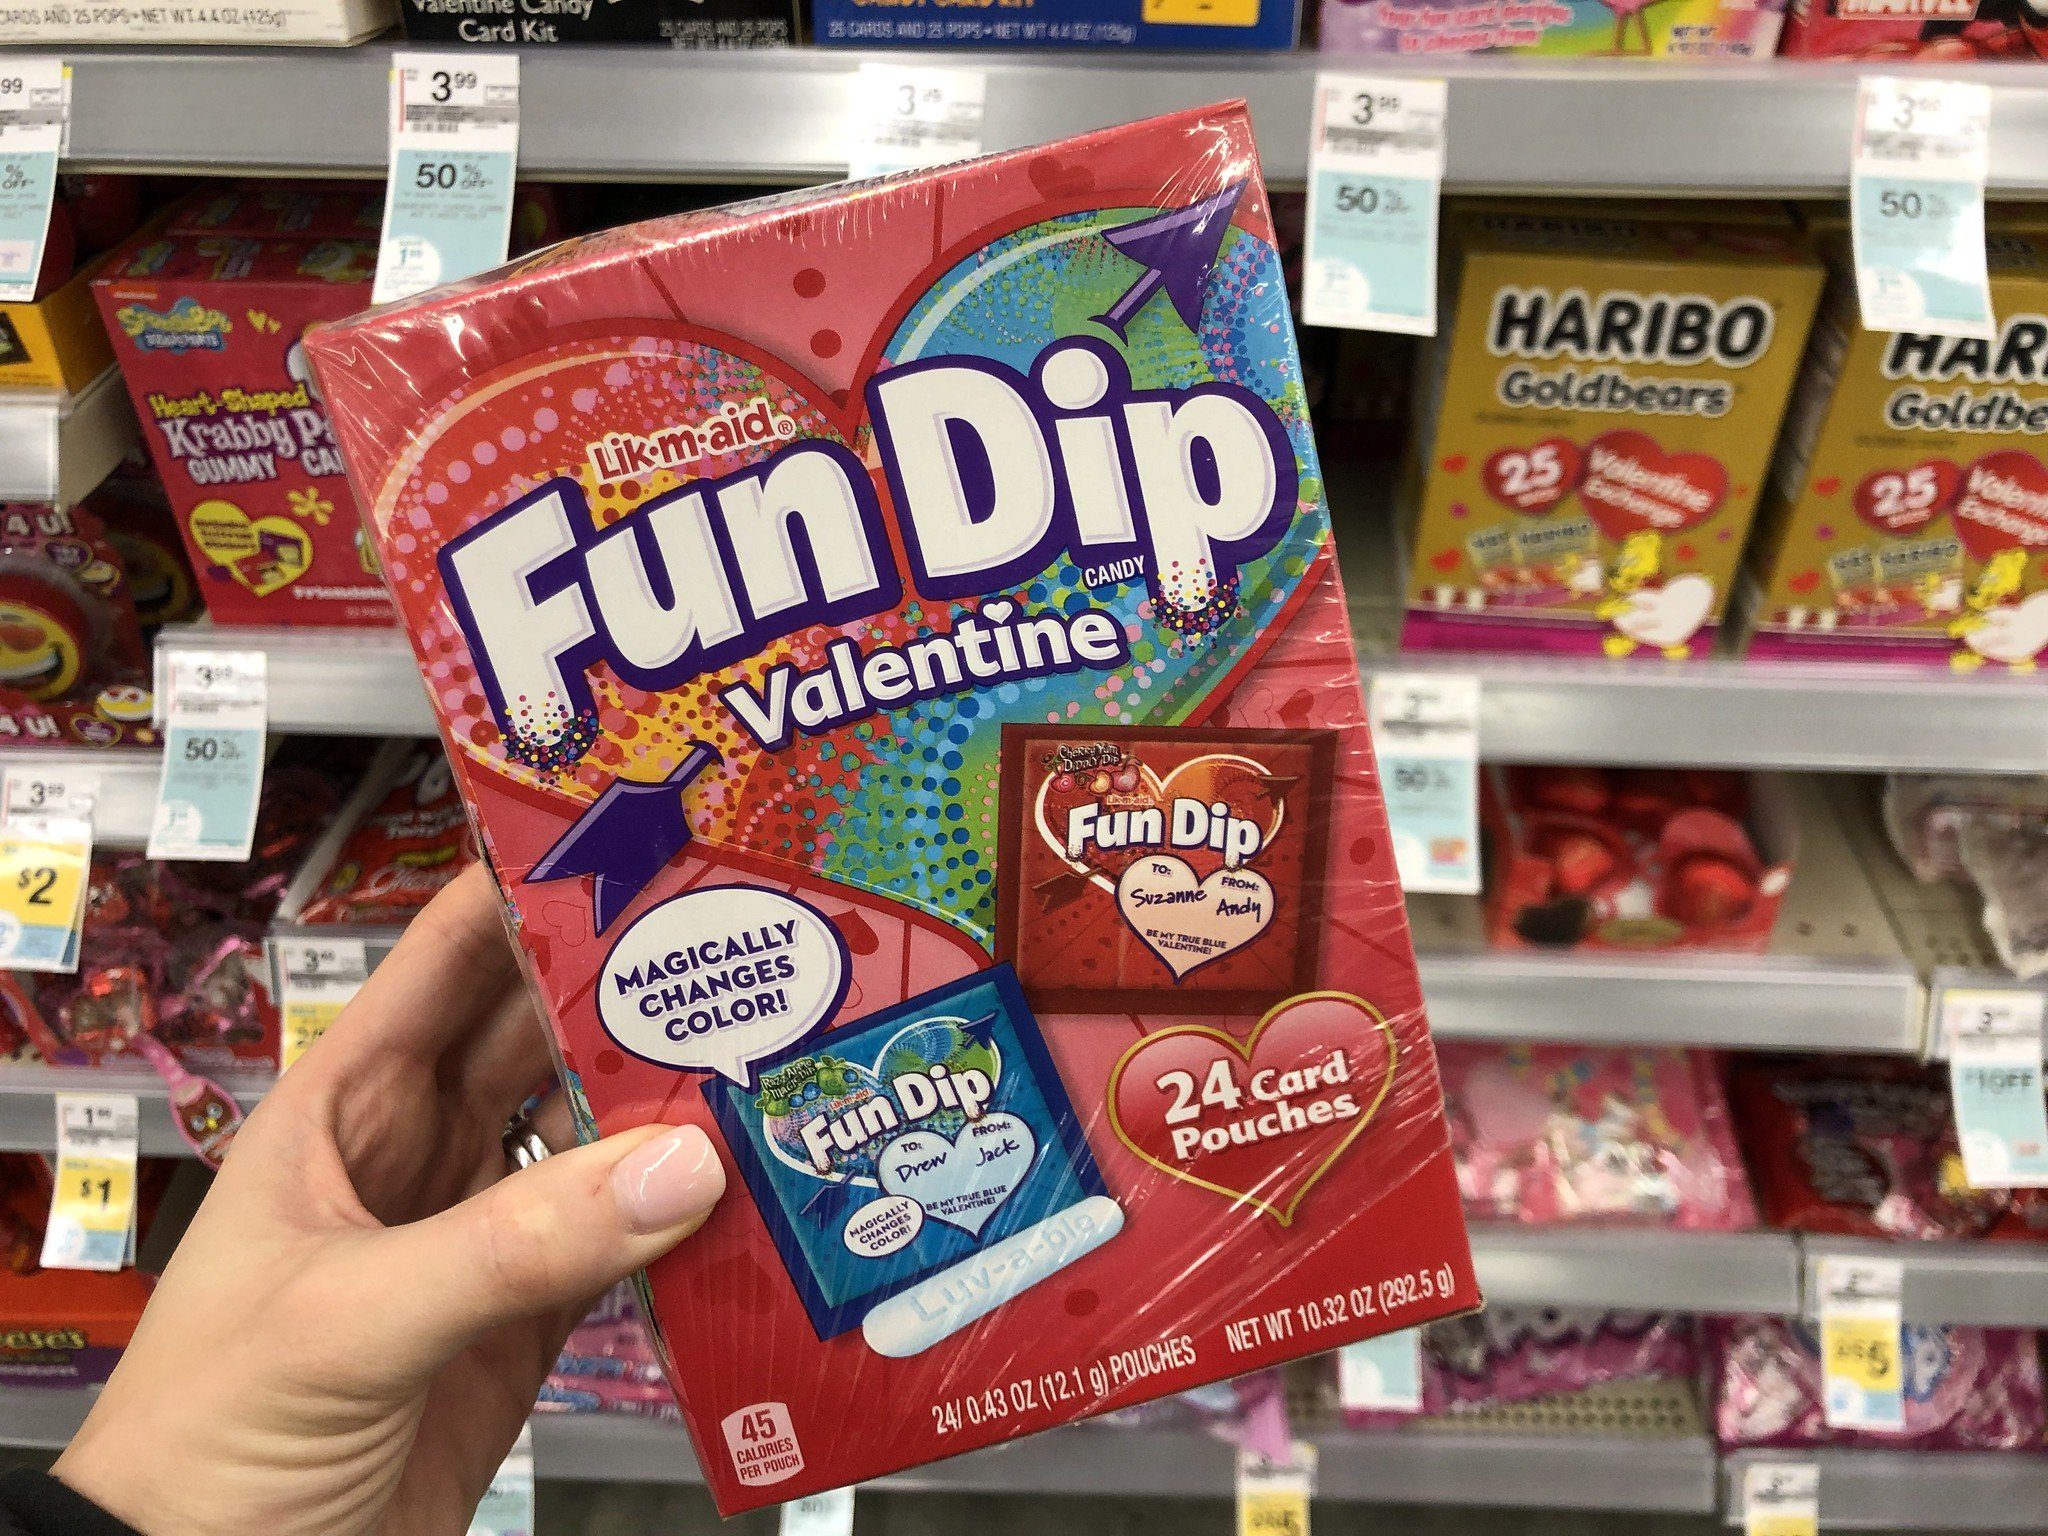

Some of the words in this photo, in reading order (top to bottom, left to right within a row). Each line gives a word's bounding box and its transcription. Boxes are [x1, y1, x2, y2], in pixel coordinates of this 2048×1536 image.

[459, 18, 516, 42] Card
[520, 19, 559, 42] Kit
[1490, 292, 1769, 361] HARIBO
[1501, 370, 1727, 415] Goldbears
[159, 416, 298, 459] Krabby
[187, 452, 277, 484] GUMMY
[1499, 445, 1563, 494] 25
[1872, 466, 1937, 517] 25
[451, 451, 880, 748] Fun
[877, 348, 1277, 611] Dip
[1085, 555, 1145, 588] CANDY
[724, 601, 1121, 745] Valentine
[1067, 802, 1163, 858] Fun
[1171, 798, 1261, 869] Dip
[1152, 863, 1171, 875] TO:
[1221, 876, 1259, 891] FROM:
[17, 867, 58, 905] $2
[1130, 888, 1207, 908] Suzanne
[1216, 896, 1262, 923] Andy
[1146, 928, 1157, 938] BE
[1161, 931, 1175, 941] MY
[1177, 933, 1200, 945] TRUE
[1202, 937, 1227, 949] BLUE
[1157, 939, 1212, 955] VALENTINE!
[613, 919, 796, 996] MAGICALLY
[638, 954, 796, 1018] CHANGES
[664, 988, 789, 1042] COLOR!
[1155, 1059, 1242, 1125] 24
[1250, 1049, 1350, 1101] Card
[800, 1096, 898, 1173] Fun
[892, 1064, 991, 1121] Dip
[972, 1121, 1012, 1138] FROM:
[1171, 1093, 1361, 1161] Pouches
[901, 1141, 922, 1153] TO:
[976, 1138, 1020, 1167] Jack
[895, 1152, 947, 1183] Drew
[926, 1201, 938, 1212] BE
[940, 1197, 954, 1207] MY
[956, 1191, 981, 1204] TRUE
[982, 1185, 1007, 1197] BLUE
[940, 1197, 996, 1216] VALENTINE!
[849, 1200, 909, 1238] MAGICALLY
[859, 1213, 912, 1244] CHANGES
[869, 1224, 912, 1251] COLOR!
[1224, 1316, 1262, 1354] NET
[1263, 1308, 1295, 1342] WT
[1296, 1294, 1350, 1334] 10.32
[1350, 1285, 1378, 1318] OZ
[1378, 1269, 1435, 1316] (292.5
[1436, 1262, 1456, 1299] g)
[931, 1398, 963, 1435] 24/
[966, 1387, 1009, 1425] 0.43
[1010, 1379, 1039, 1413] OZ
[1040, 1366, 1084, 1411] (12.1
[1089, 1360, 1109, 1398] g)
[1109, 1335, 1197, 1385] POUCHES
[741, 1408, 777, 1442] 45
[736, 1436, 794, 1465] CALORIES
[739, 1464, 762, 1480] PER
[763, 1453, 800, 1474] POUCH
